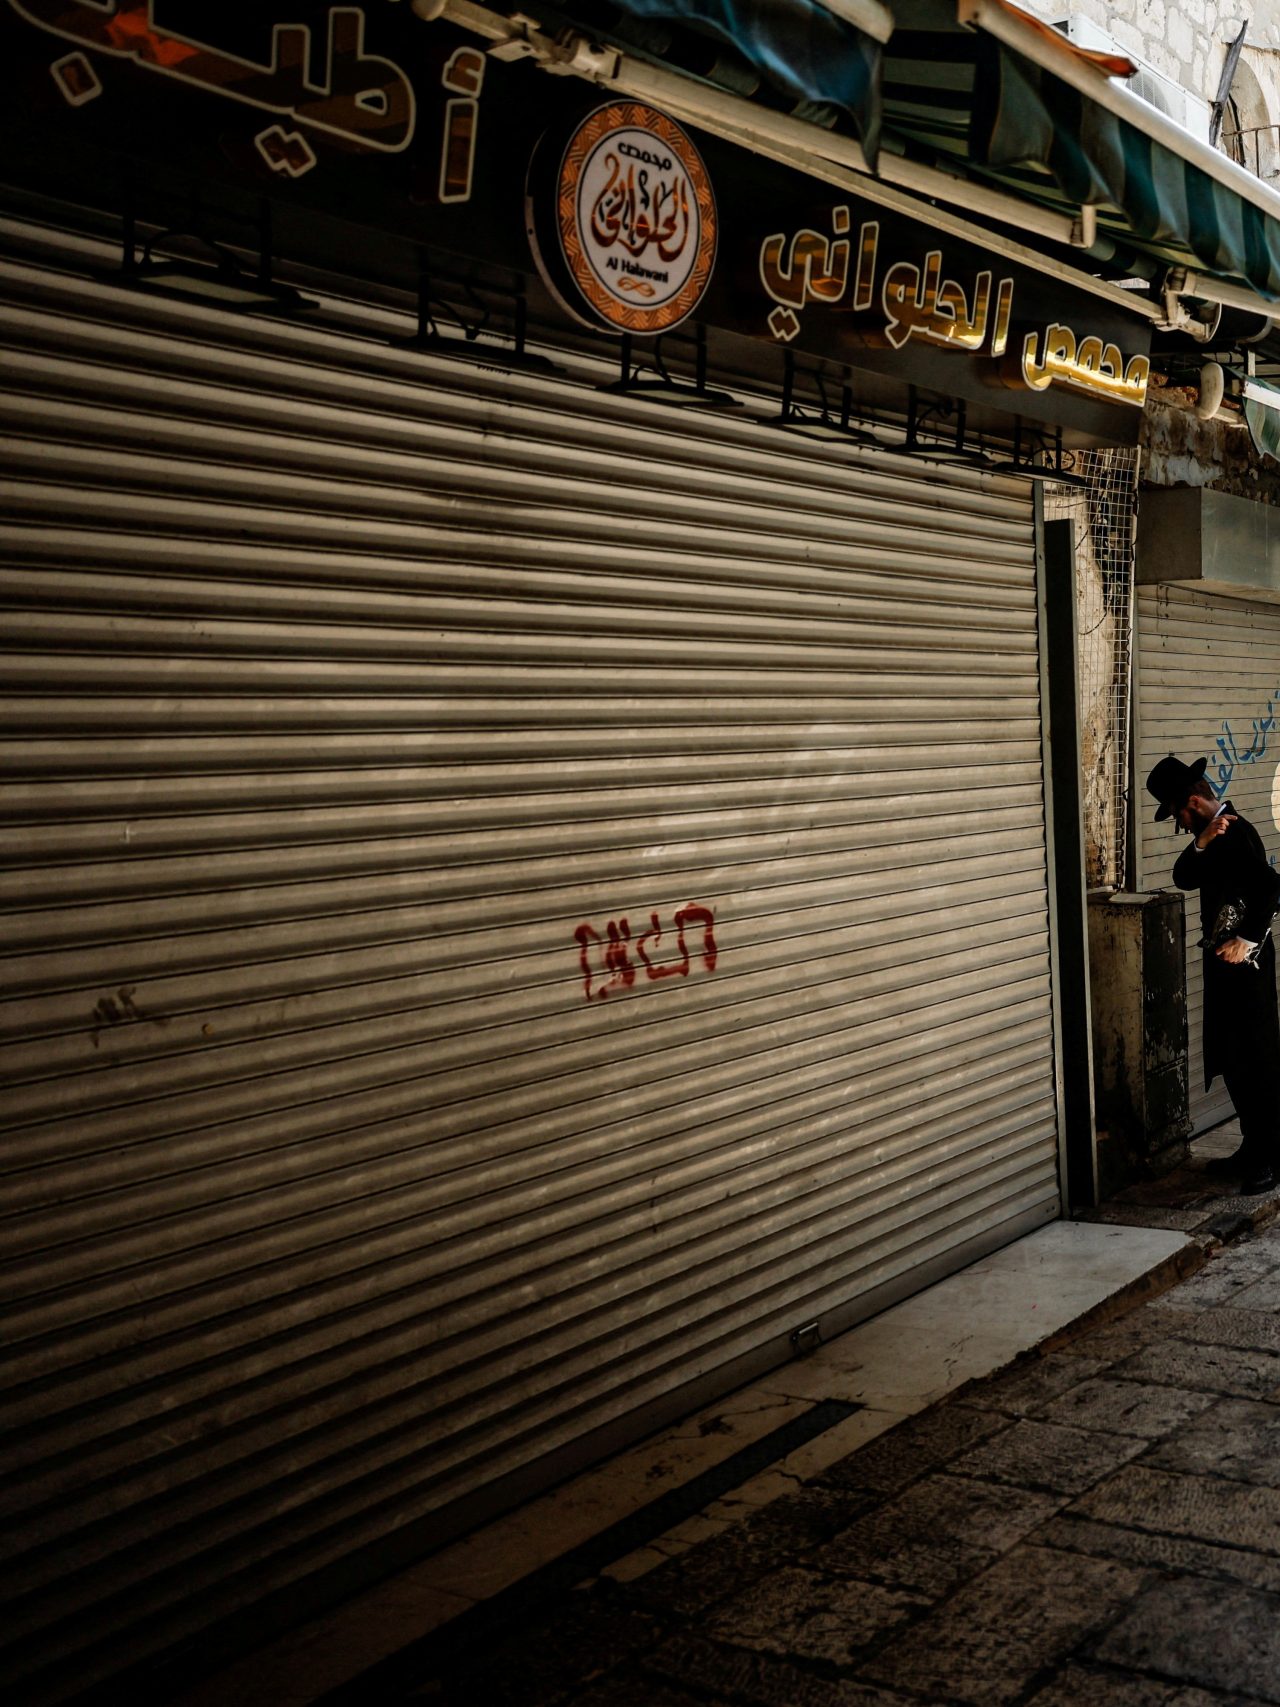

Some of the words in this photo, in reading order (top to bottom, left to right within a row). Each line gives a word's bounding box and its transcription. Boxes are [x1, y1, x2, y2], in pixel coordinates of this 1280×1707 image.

[606, 257, 618, 270] Al
[621, 259, 668, 283] Halawani
[759, 205, 1014, 358] الحلواني
[1021, 322, 1150, 408] محمص
